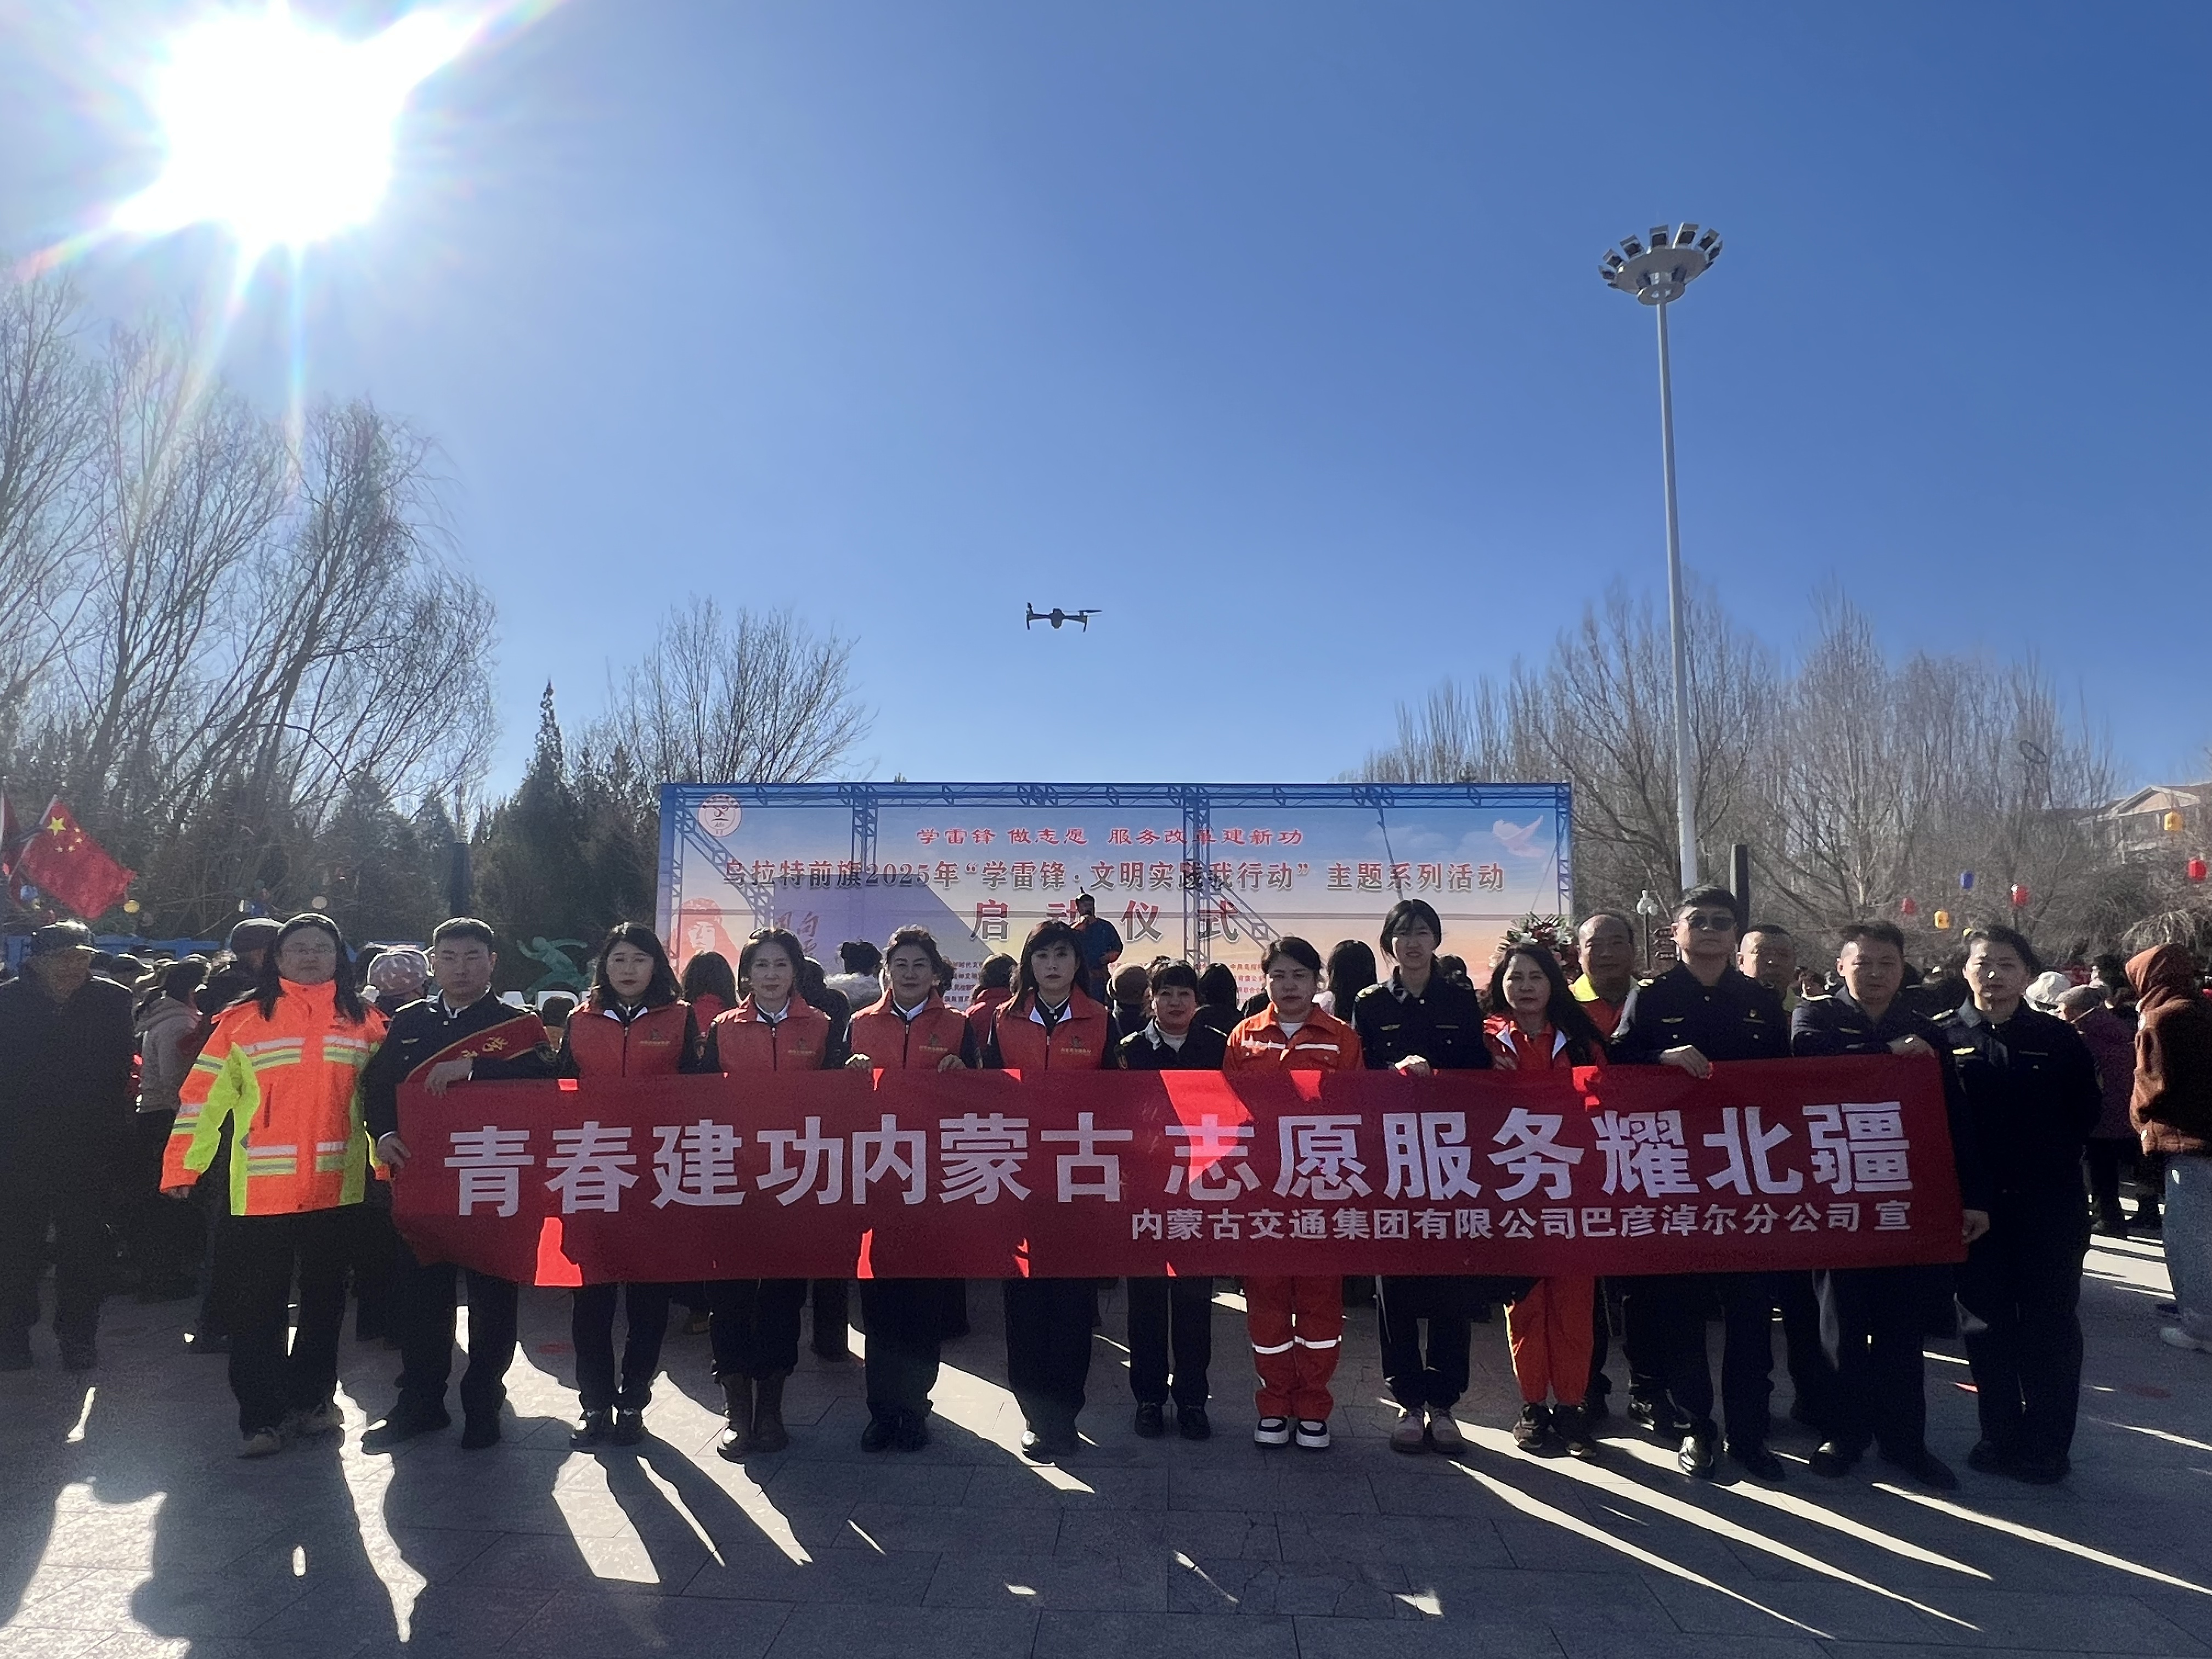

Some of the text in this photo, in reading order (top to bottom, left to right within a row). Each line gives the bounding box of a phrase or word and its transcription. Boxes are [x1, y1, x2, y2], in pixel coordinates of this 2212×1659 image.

[916, 827, 996, 845] 学雷锋
[1007, 827, 1088, 845] 做志愿
[1327, 862, 1505, 891] 主题系列活动
[444, 1101, 1914, 1218] 青春建功内蒙古 志愿服务耀北疆
